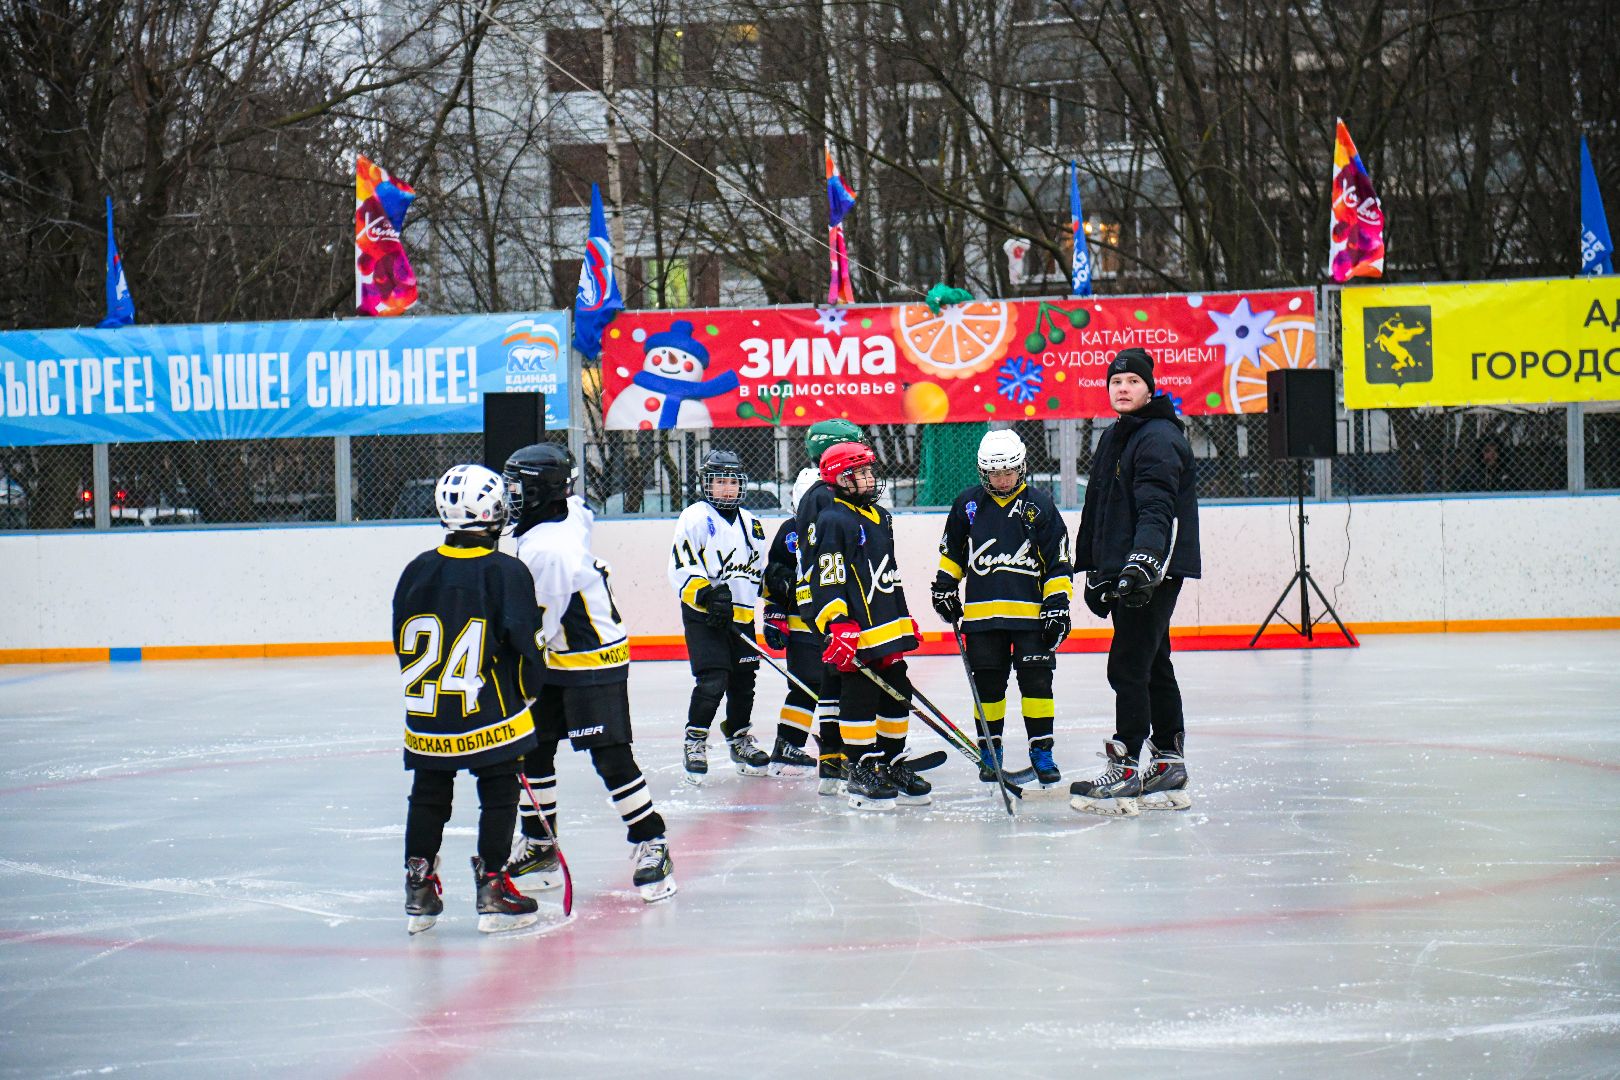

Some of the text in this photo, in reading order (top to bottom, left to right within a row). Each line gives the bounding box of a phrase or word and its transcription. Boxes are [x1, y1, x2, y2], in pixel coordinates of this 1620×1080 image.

[1081, 327, 1179, 345] КАТАЙТЕСЬ
[1042, 348, 1217, 368] С УДОВОТВИЕМ!
[0, 346, 478, 418] ЫСТРЕЕ! ВЫШЕ! СИЛЬНЕЕ!
[505, 373, 557, 385] ЕДИНАЯ
[739, 381, 896, 398] в подмосковье
[672, 540, 698, 569] 11
[819, 552, 846, 587] 28
[1039, 609, 1069, 620] CCM
[399, 613, 487, 718] 24
[406, 723, 516, 753] ОВСКАЯ ОБЛАСТЬ
